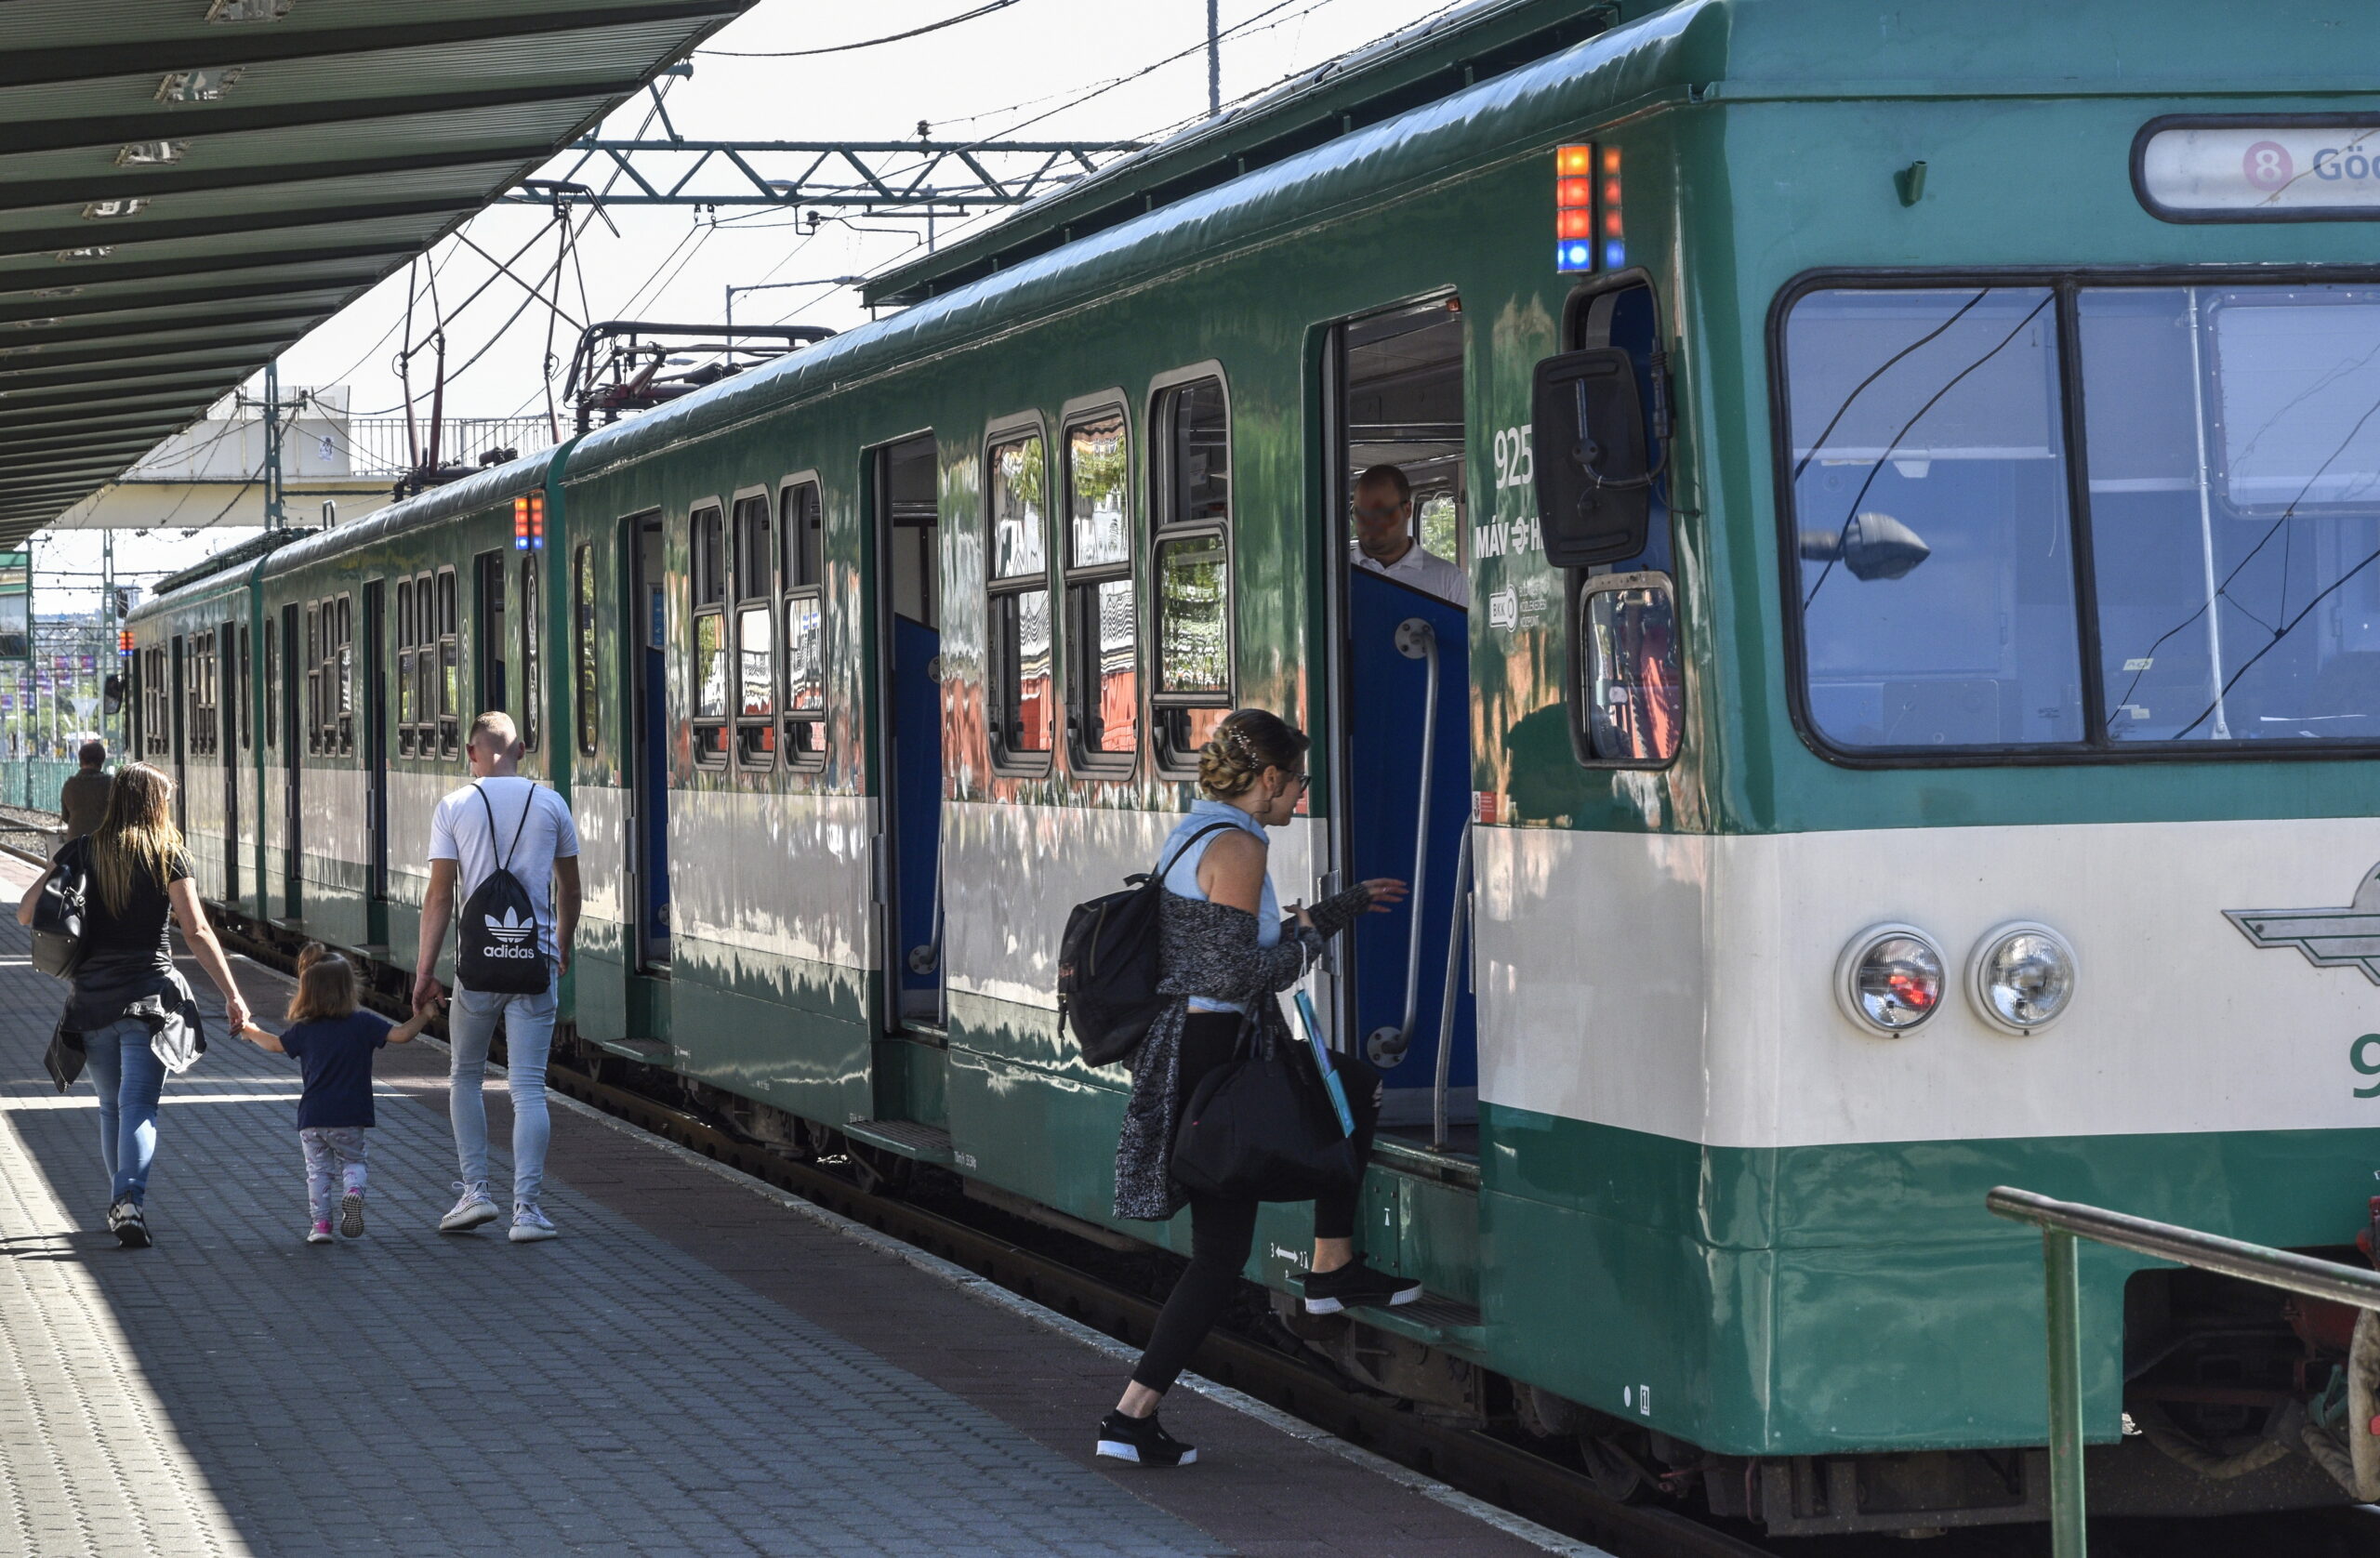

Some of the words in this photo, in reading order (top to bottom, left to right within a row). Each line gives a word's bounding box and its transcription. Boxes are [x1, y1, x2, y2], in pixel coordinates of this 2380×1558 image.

[2255, 150, 2282, 182] 8
[1494, 424, 1534, 490] 925
[1475, 514, 1510, 559] MÁV
[1493, 602, 1505, 617] BKK
[483, 944, 535, 958] adidas
[1271, 1242, 1275, 1258] 3
[1643, 1391, 1647, 1410] 1
